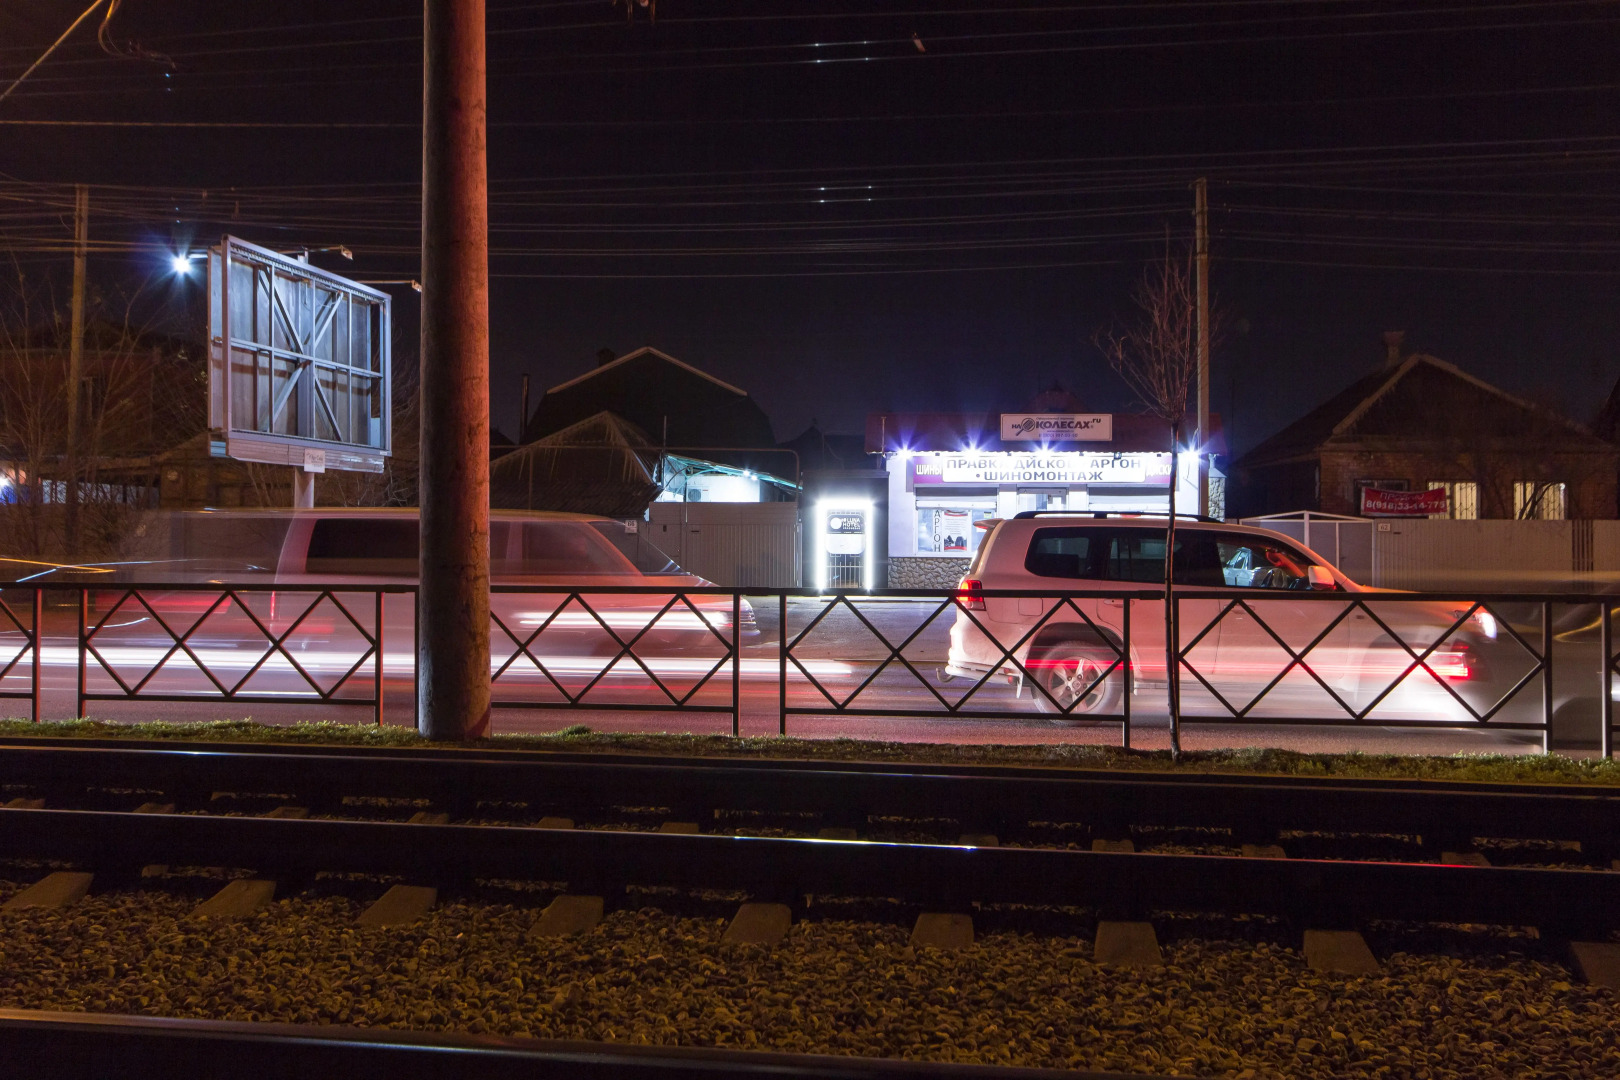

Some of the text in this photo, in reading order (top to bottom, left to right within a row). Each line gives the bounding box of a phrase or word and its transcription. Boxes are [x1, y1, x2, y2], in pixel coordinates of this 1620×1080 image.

[946, 459, 1141, 470] ПРАВК ДИСКО АРГОН
[984, 471, 1103, 481] ШИНОМОНТАЖ
[933, 509, 941, 552] АРГОН
